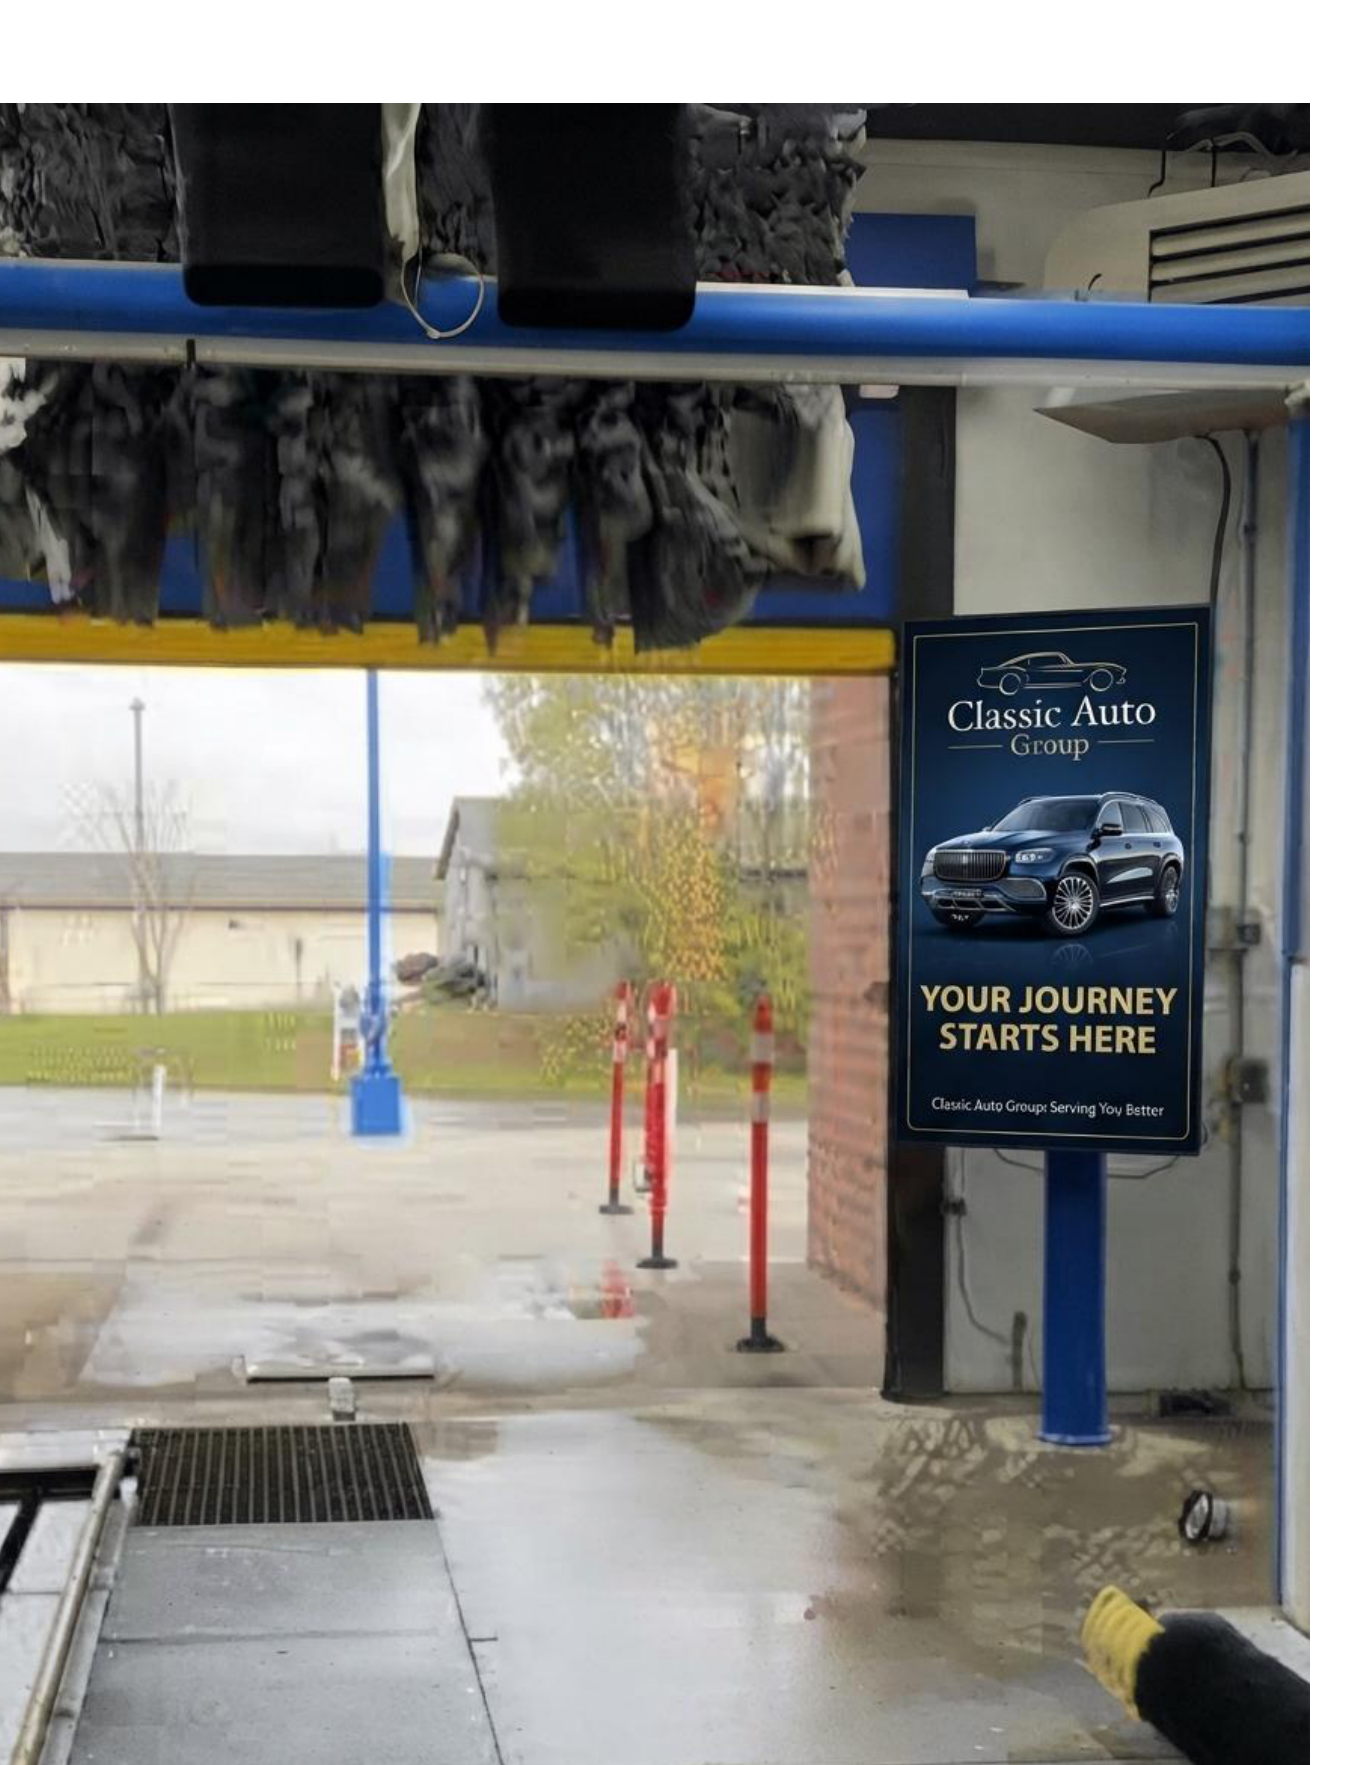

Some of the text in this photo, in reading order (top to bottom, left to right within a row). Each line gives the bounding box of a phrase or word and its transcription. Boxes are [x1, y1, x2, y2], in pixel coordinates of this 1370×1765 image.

[948, 695, 1156, 732] Classic Auto
[1010, 733, 1090, 761] Group
[920, 984, 1178, 1015] YOUR JOURNEY
[939, 1022, 1156, 1054] STARTS HERE
[973, 1098, 1003, 1113] Auto
[1050, 1100, 1097, 1119] Serving
